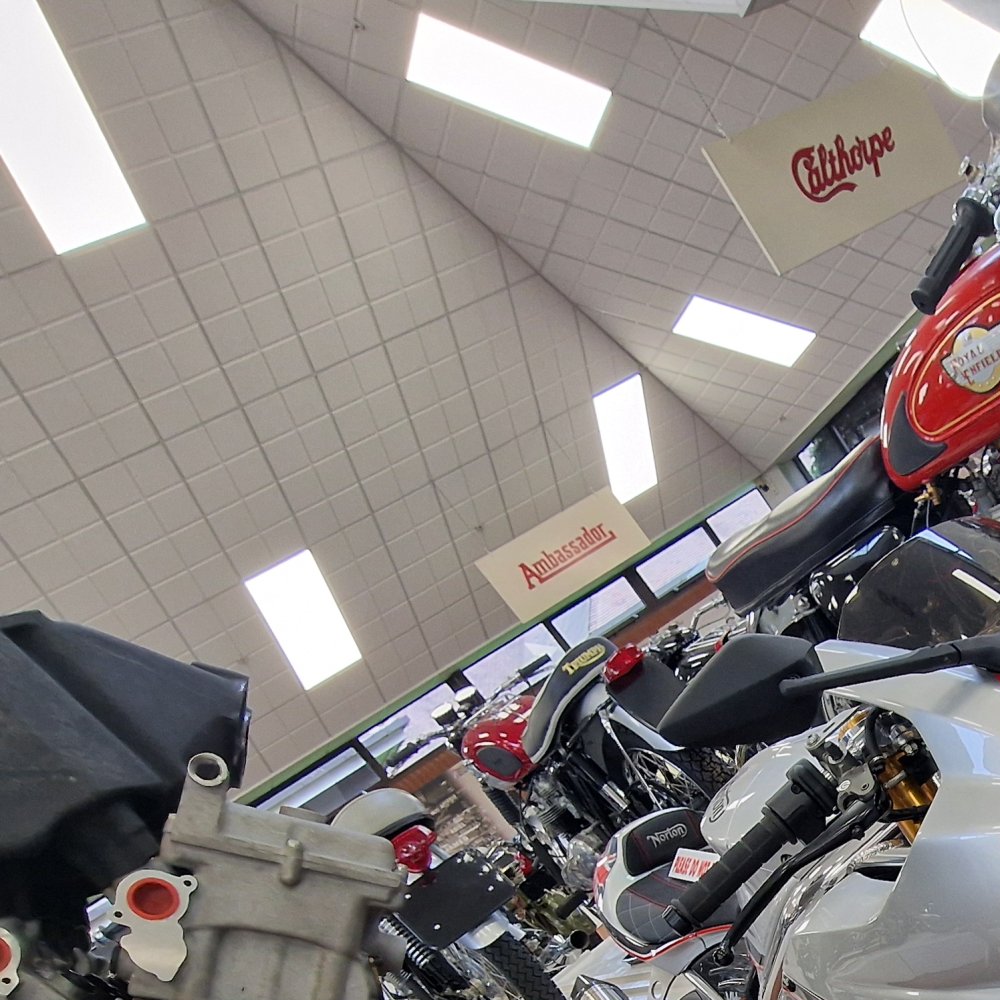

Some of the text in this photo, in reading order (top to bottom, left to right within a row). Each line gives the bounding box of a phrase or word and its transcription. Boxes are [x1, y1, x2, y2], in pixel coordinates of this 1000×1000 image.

[791, 126, 896, 203] Calthorpe
[951, 343, 984, 374] ROYAL
[518, 523, 617, 590] Ambassador
[561, 643, 606, 675] TRIUMPH
[646, 823, 688, 848] Norton
